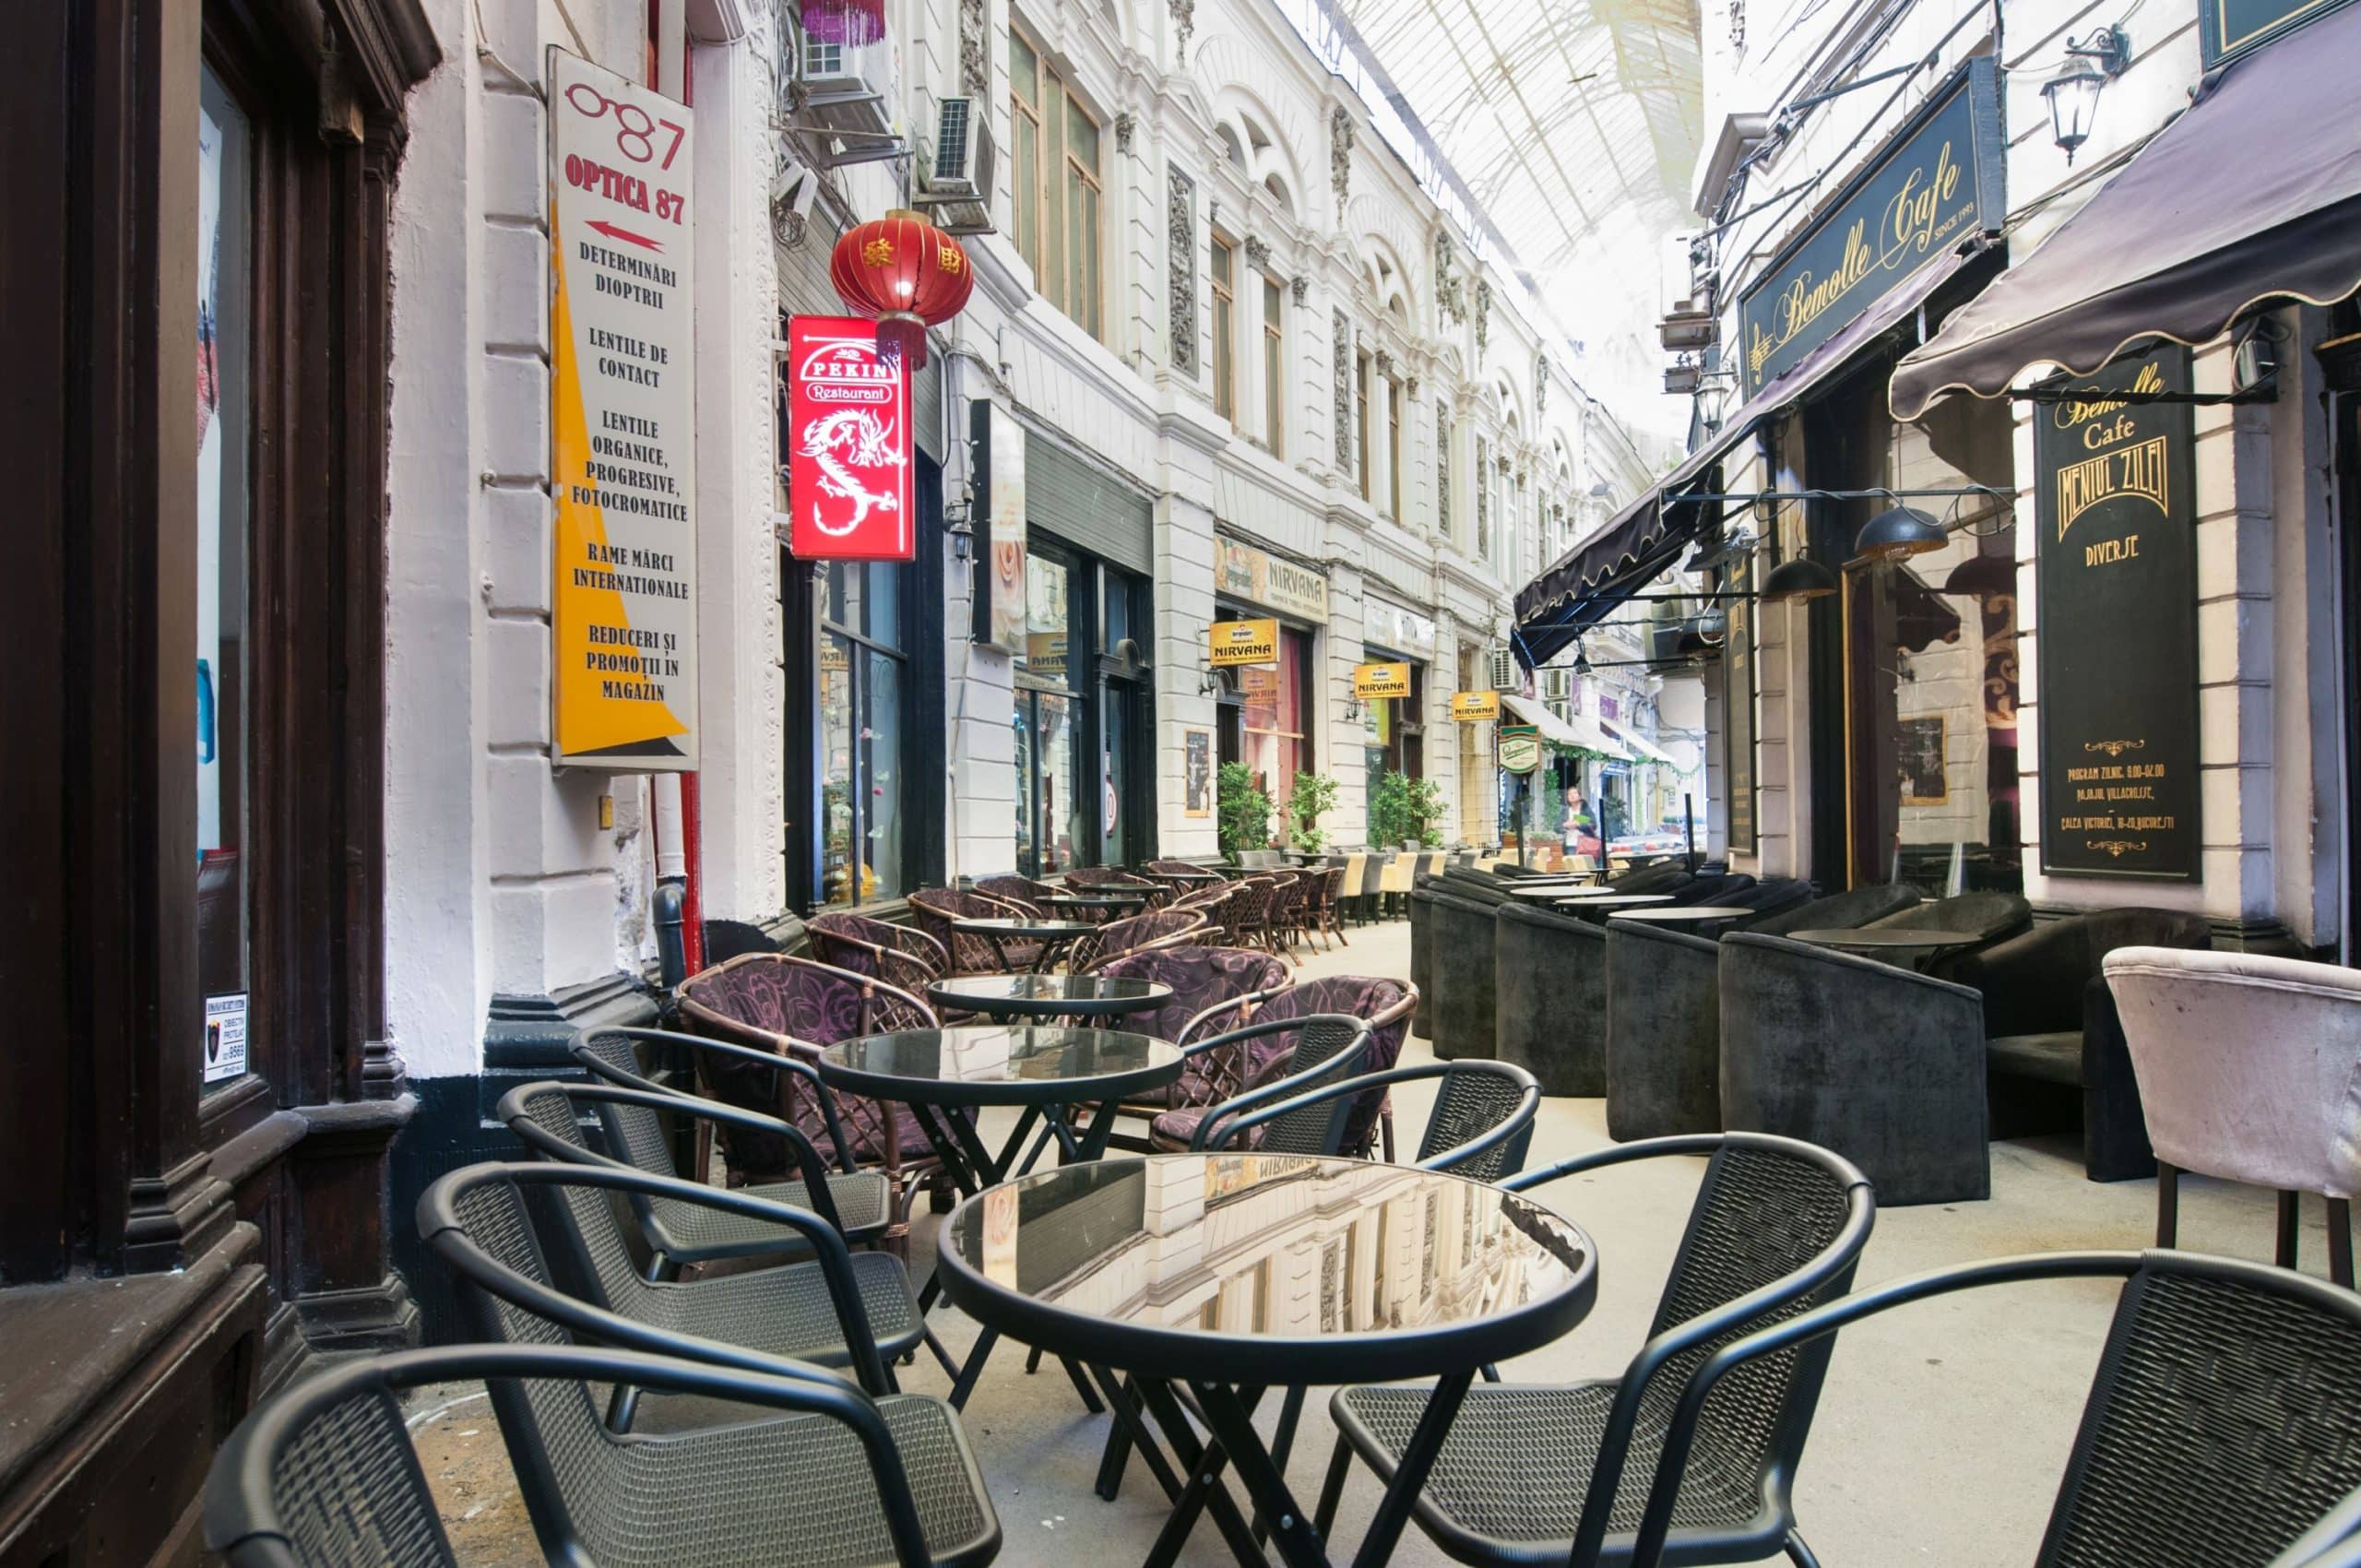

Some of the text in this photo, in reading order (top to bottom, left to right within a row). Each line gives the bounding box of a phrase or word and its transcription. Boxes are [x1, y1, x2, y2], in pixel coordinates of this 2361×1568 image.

[565, 153, 684, 225] OPTICA 87
[1773, 141, 1961, 343] Bemolle Cafe
[579, 242, 676, 288] DETERMINĂRI
[595, 273, 663, 309] DIOPTRII
[589, 327, 668, 364] LENTILE DE
[599, 358, 659, 388] CONTACT
[813, 362, 887, 377] PEKIN
[813, 386, 884, 400] Restaurant
[602, 410, 658, 438] LENTILE
[2083, 414, 2134, 449] Cafe
[592, 435, 668, 469] ORGANICE,
[586, 460, 680, 497] PROGRESIVE,
[2062, 441, 2162, 529] MENIUL ZILEI
[572, 485, 687, 522] FOTOCROMATICE
[587, 543, 673, 572] RAME MĂRCI
[2086, 535, 2139, 567] DIVERSE
[574, 568, 688, 600] INTERNATIONALE
[1269, 561, 1322, 603] NIRVANA
[589, 624, 658, 648] REDUCERI
[1215, 645, 1271, 657] NIRVANA
[587, 652, 659, 680] PROMOȚII
[603, 681, 664, 702] MAGAZIN
[1358, 683, 1405, 692] NIRVANA
[1455, 707, 1494, 715] NIRVANA
